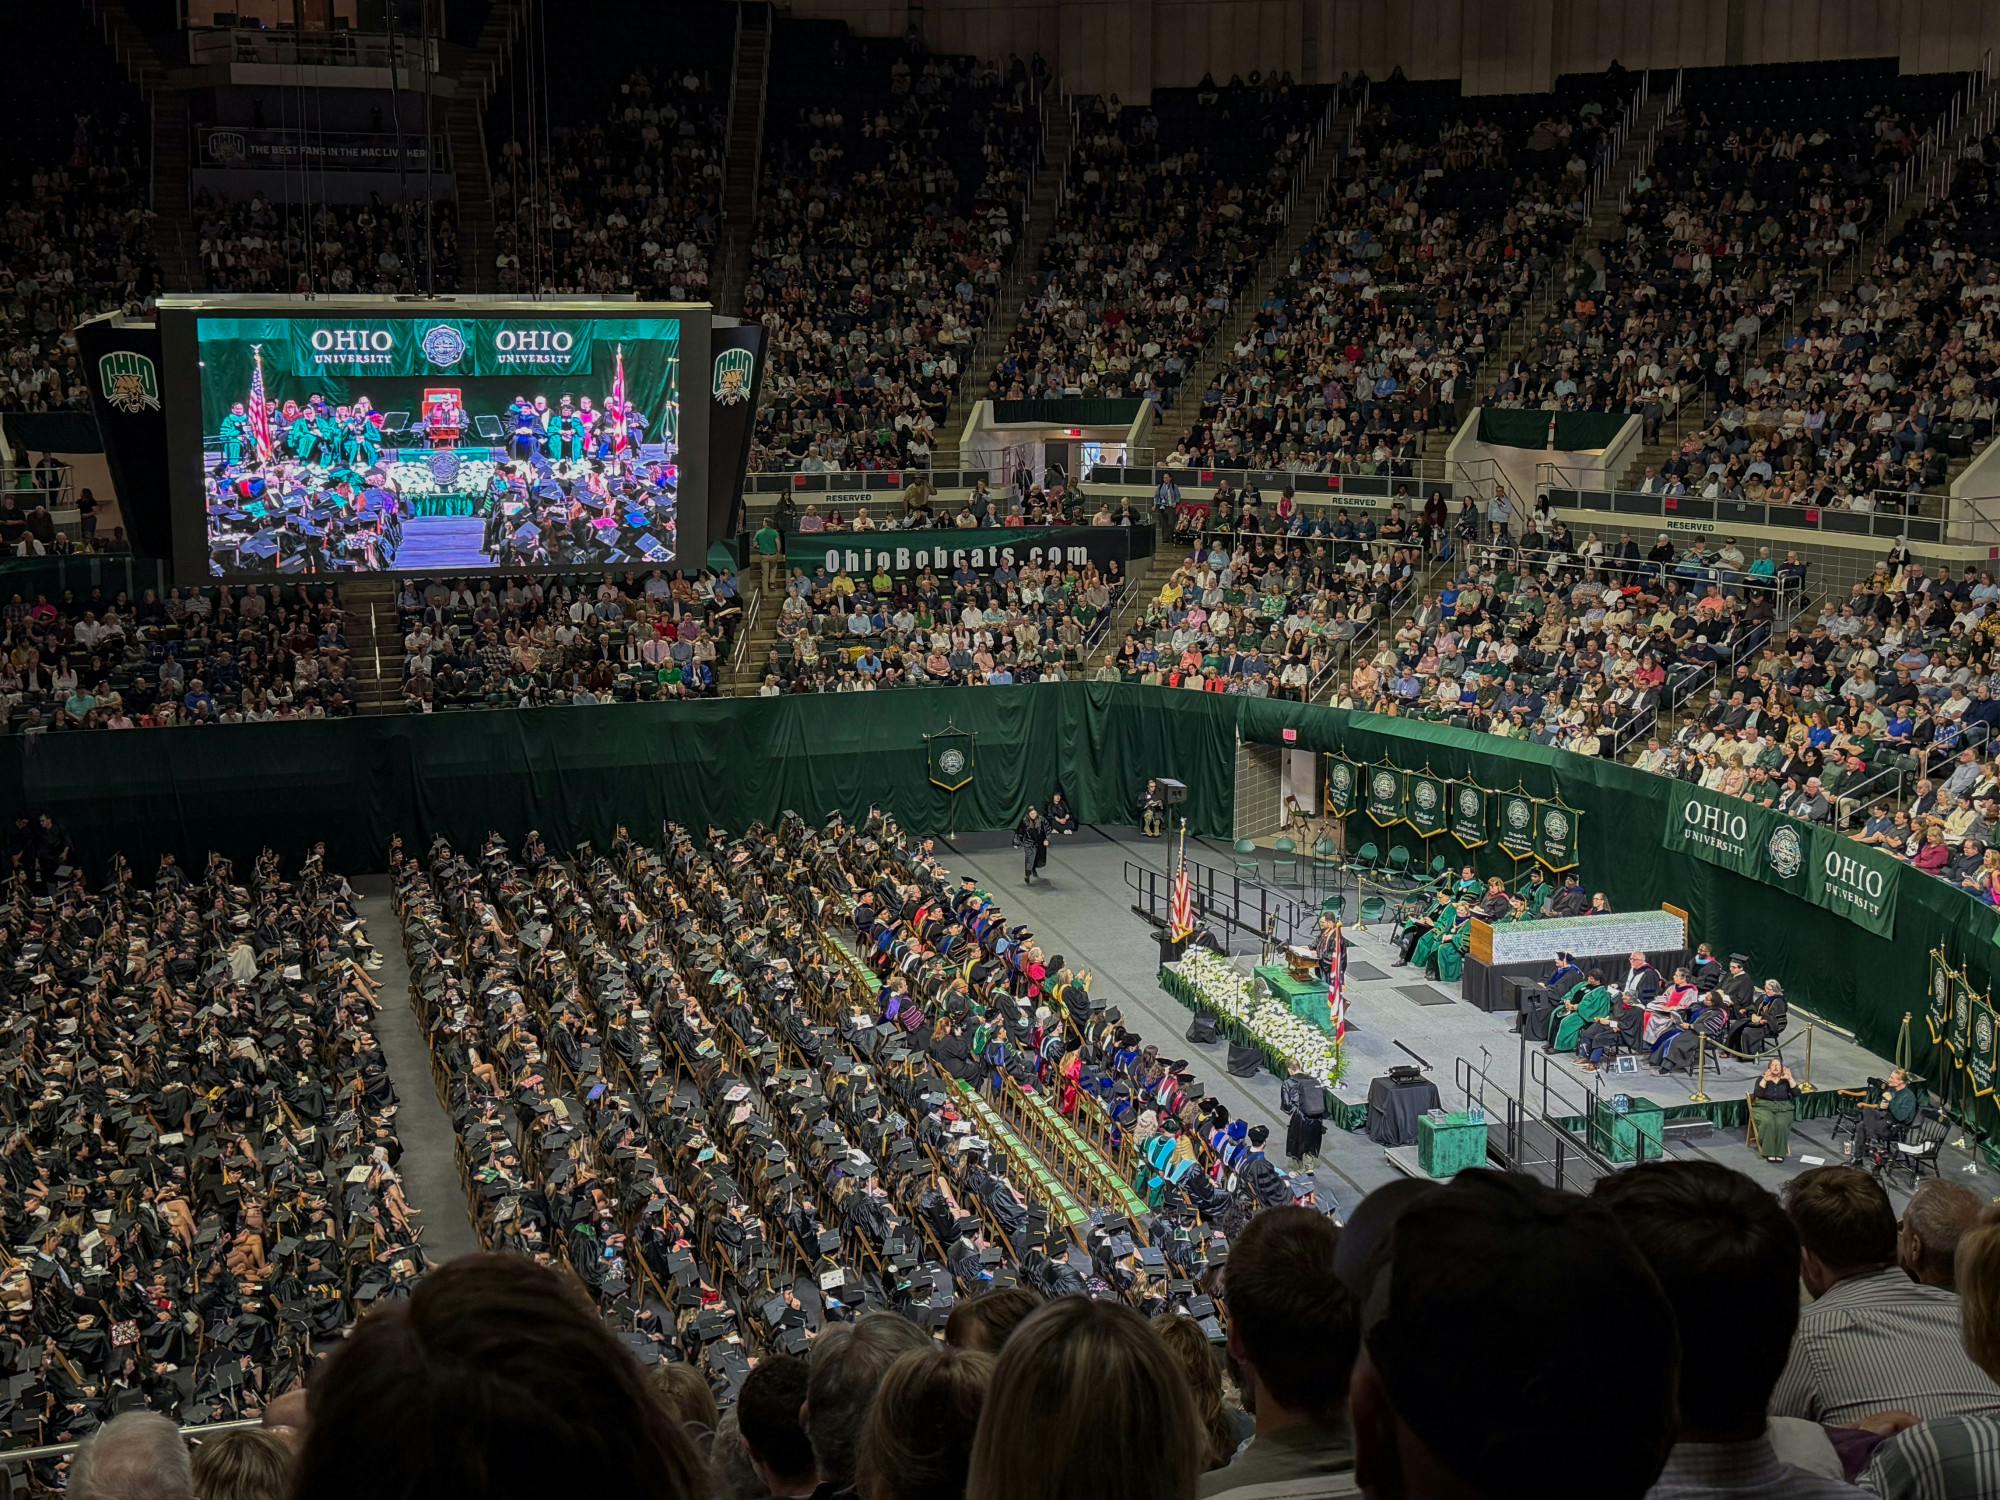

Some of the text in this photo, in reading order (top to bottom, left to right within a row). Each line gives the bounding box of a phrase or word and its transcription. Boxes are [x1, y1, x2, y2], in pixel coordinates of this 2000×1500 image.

[250, 145, 270, 154] THE
[271, 145, 299, 155] BEST
[299, 145, 326, 156] FANS
[327, 147, 339, 156] IN
[339, 147, 360, 157] THE
[360, 147, 384, 158] MAC
[311, 330, 393, 351] OHIO
[495, 330, 573, 351] OHIO
[314, 354, 392, 364] UNIVERSITY
[497, 354, 571, 364] UNIVERSITY
[825, 493, 872, 502] RESERVED
[1332, 496, 1377, 507] RESERVED
[1667, 520, 1710, 532] RESERVED
[825, 545, 1089, 573] OhioBobcats.com
[1684, 800, 1747, 841] OHIO
[1684, 828, 1745, 857] UNIVERSITY
[1825, 851, 1883, 898] OHIO
[1825, 882, 1880, 916] UNIVERSITY
